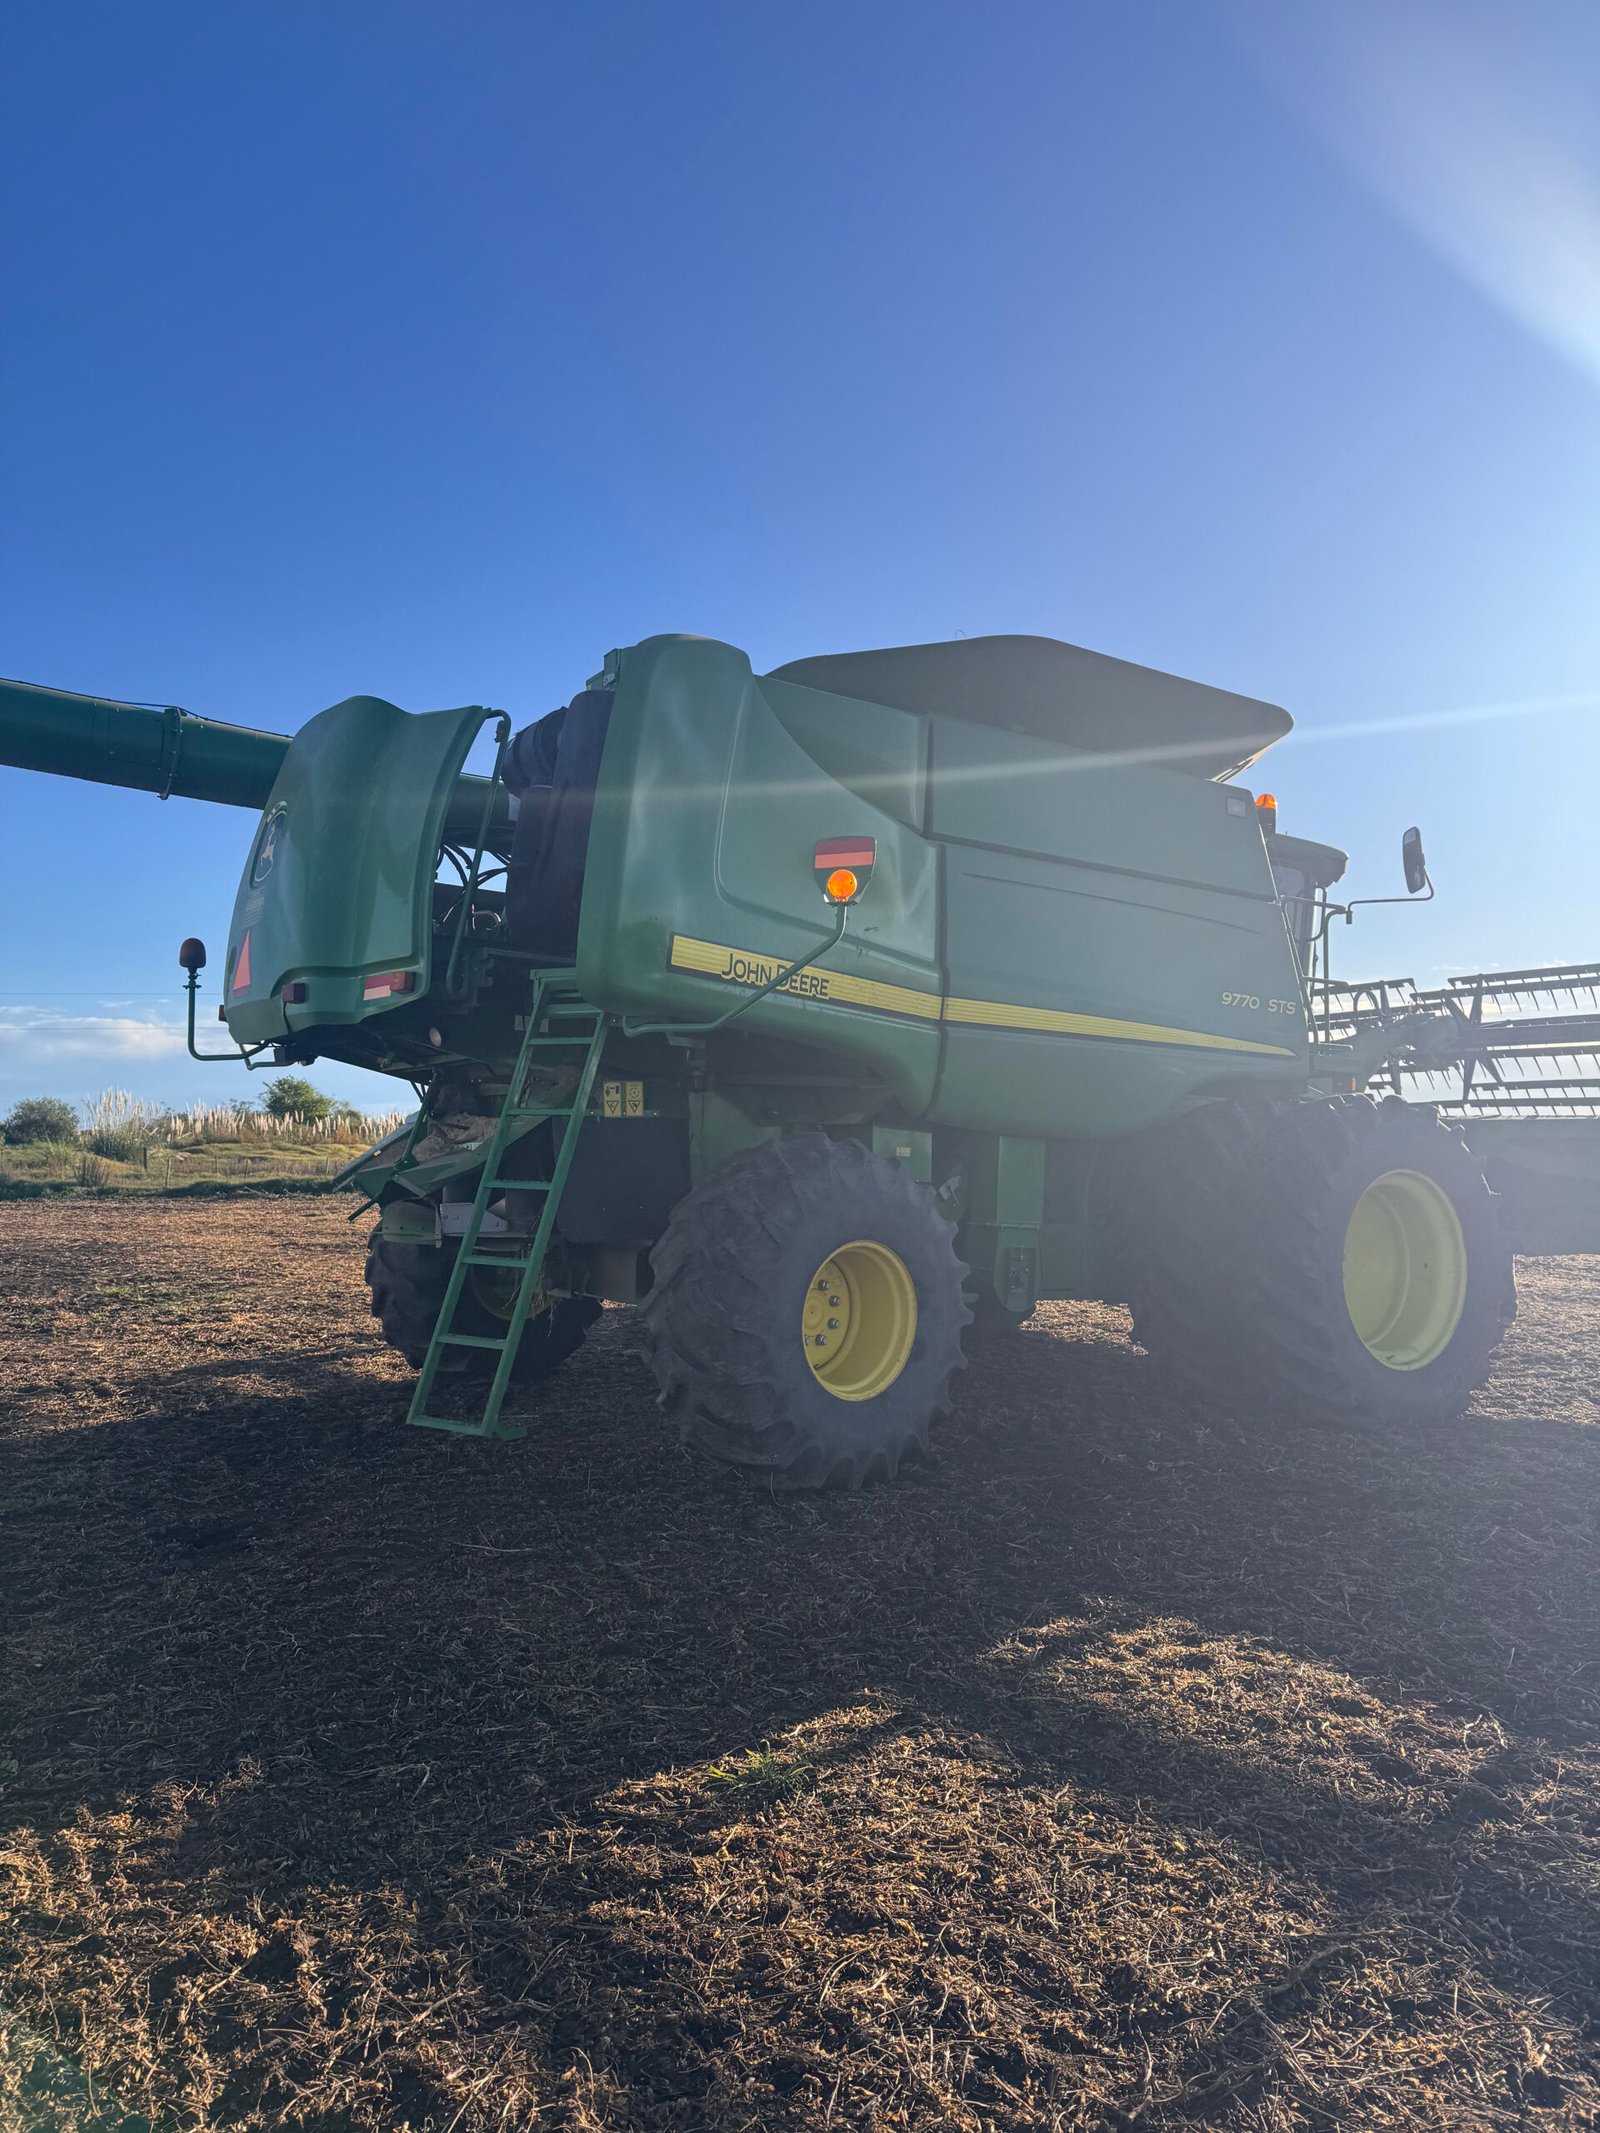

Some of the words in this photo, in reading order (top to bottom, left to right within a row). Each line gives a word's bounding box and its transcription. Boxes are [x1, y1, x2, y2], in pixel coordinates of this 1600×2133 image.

[721, 953, 773, 984] JOHN
[1221, 991, 1260, 1009] 9770
[1267, 998, 1296, 1015] STS
